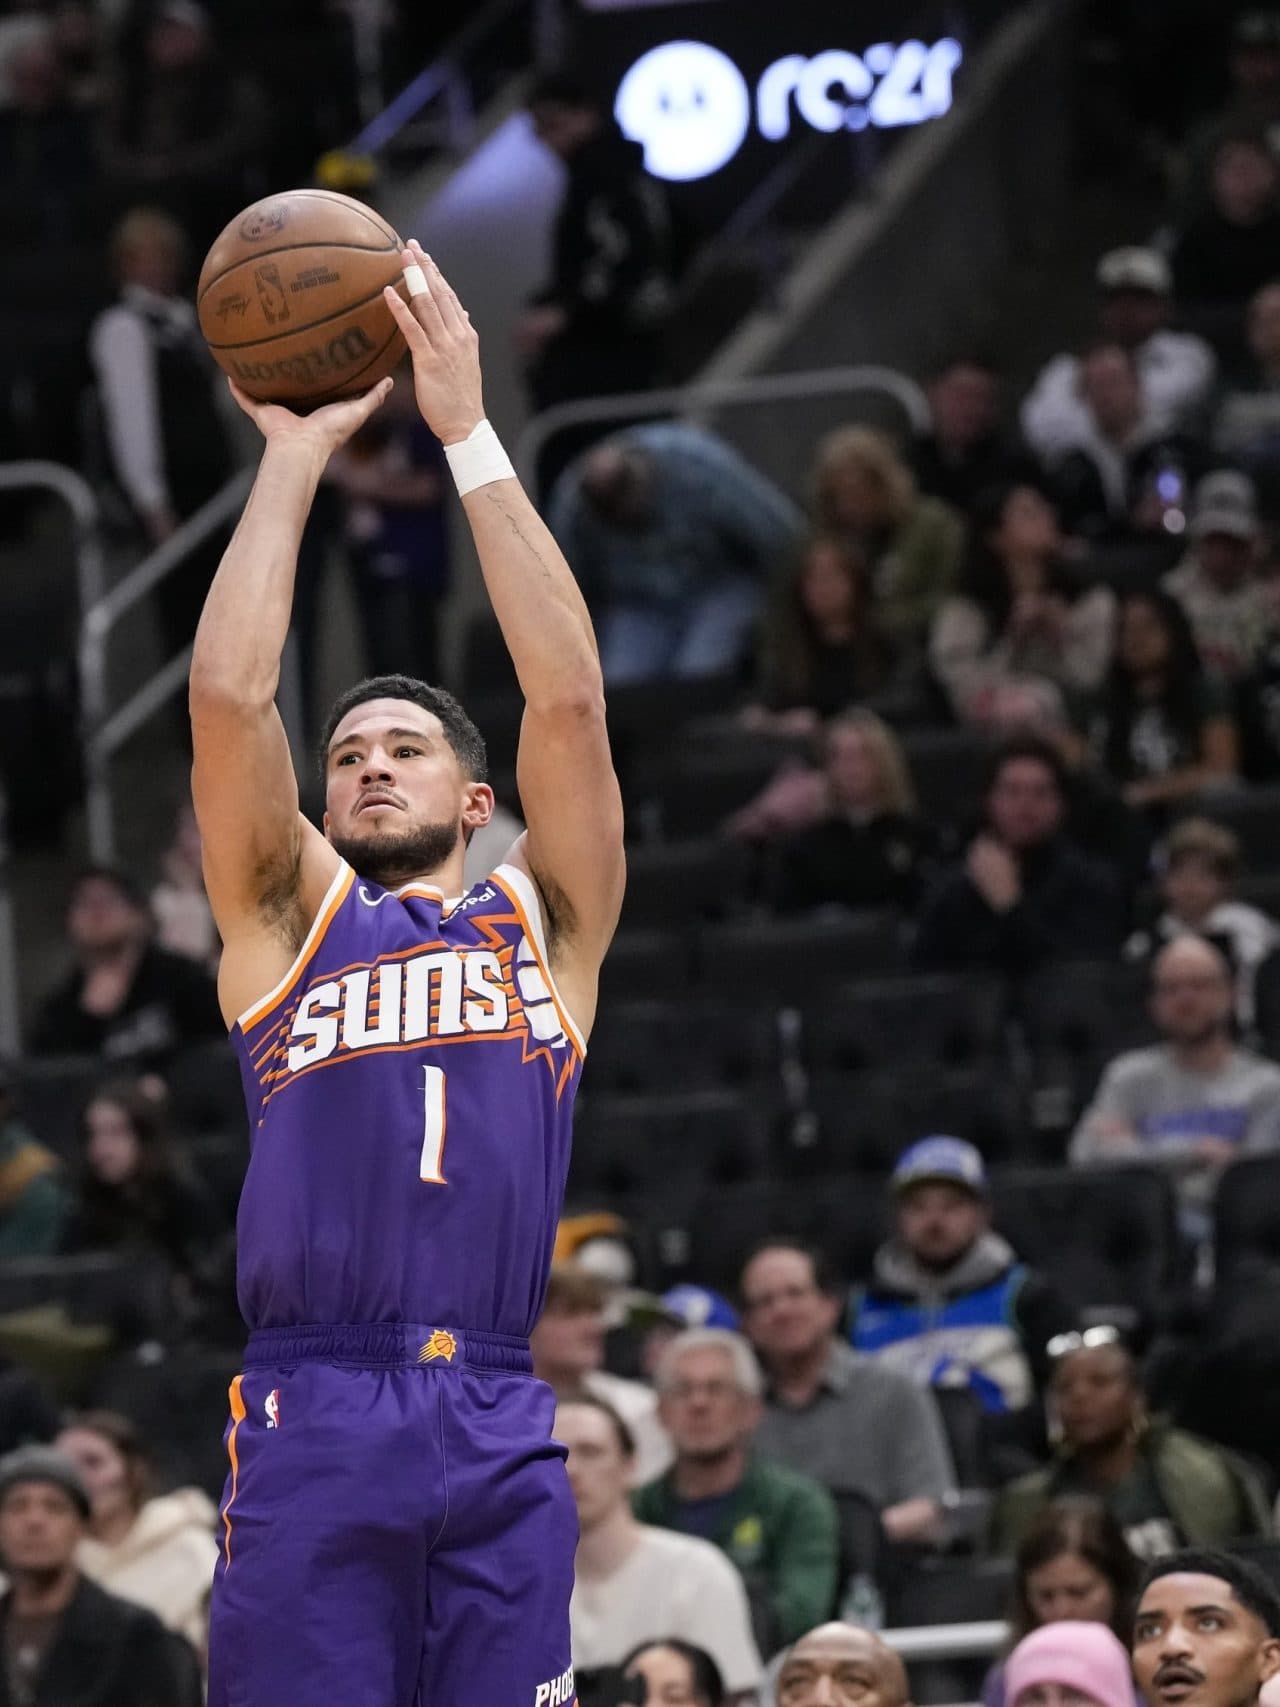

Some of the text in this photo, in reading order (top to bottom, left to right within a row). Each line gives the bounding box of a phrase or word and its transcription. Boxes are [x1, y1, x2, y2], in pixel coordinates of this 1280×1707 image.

[439, 886, 497, 924] yPal
[287, 950, 509, 1073] SUNS
[419, 1064, 448, 1185] 1
